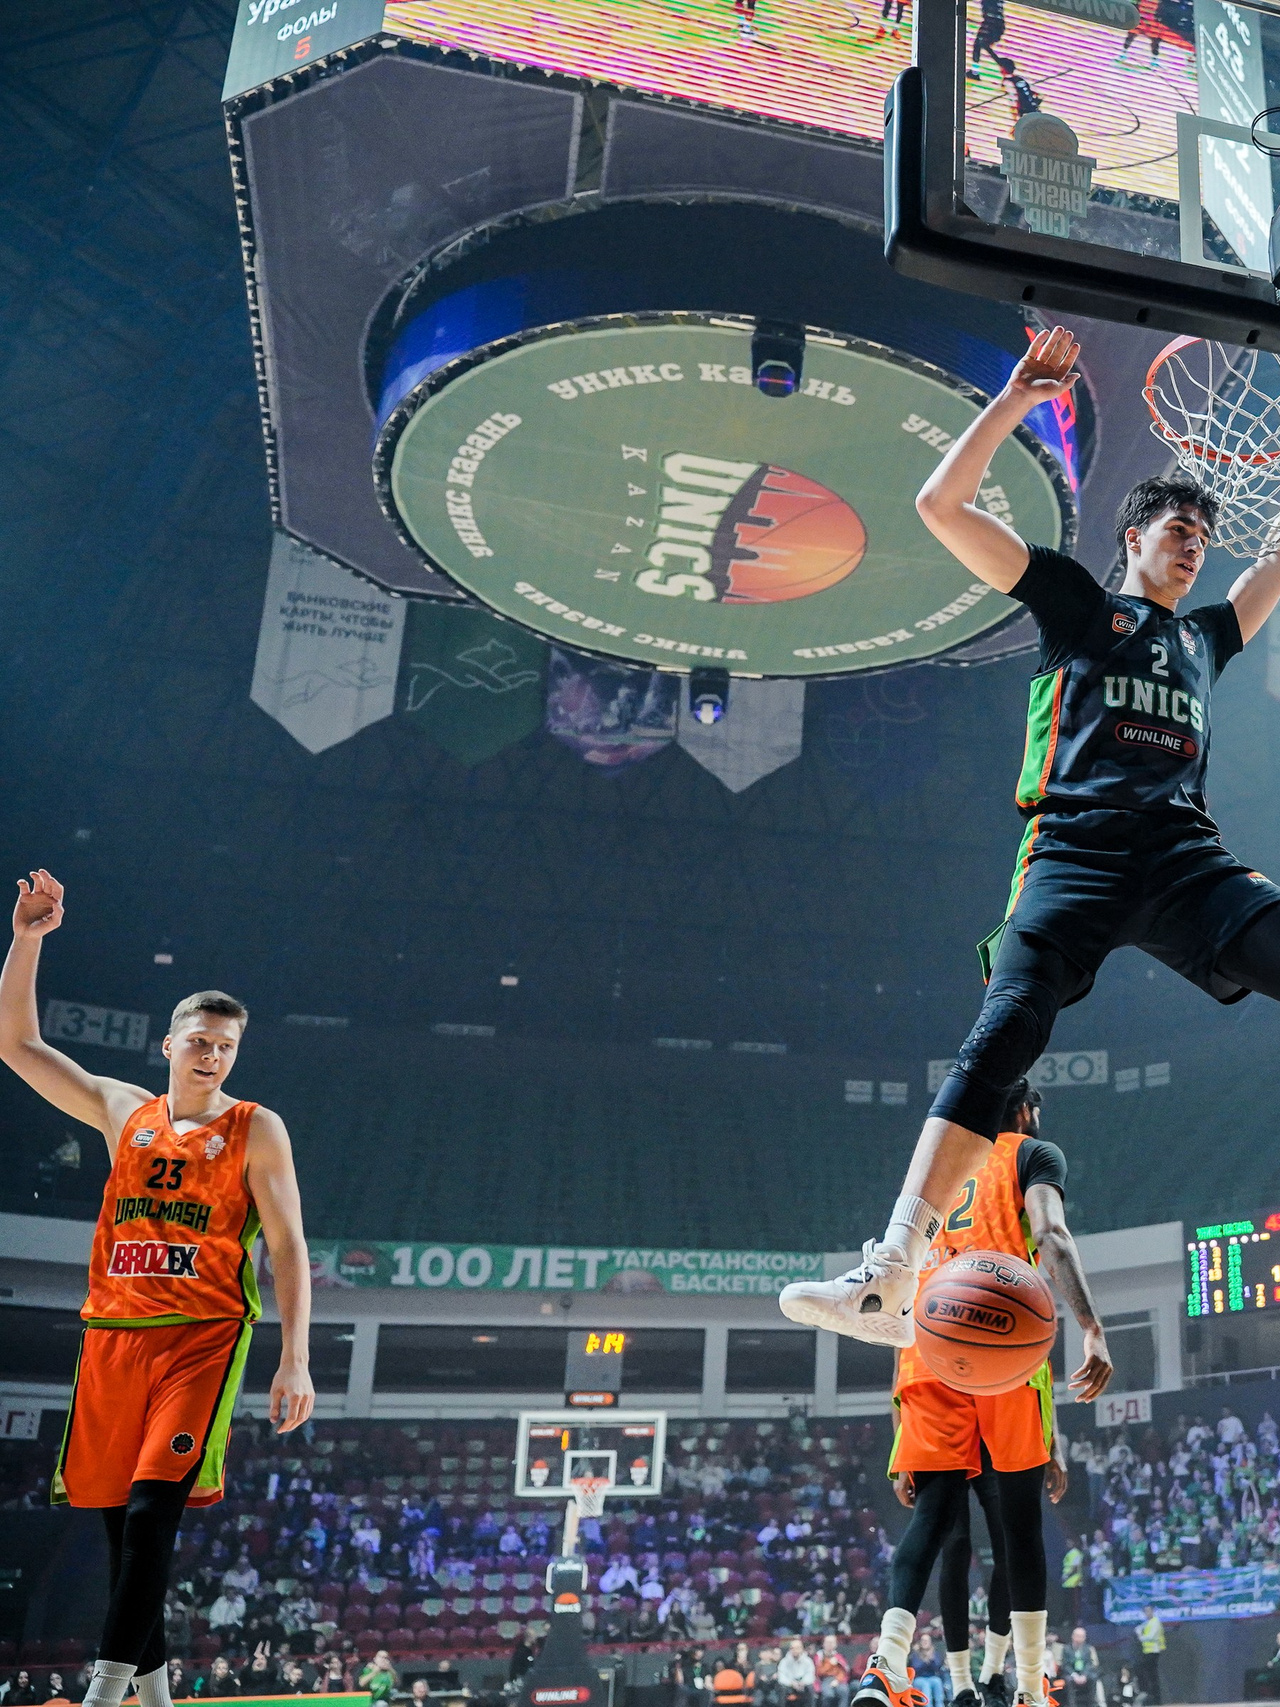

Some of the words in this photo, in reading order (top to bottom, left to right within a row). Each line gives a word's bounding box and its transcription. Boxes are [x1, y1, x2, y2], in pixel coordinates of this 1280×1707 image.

[294, 35, 312, 60] 5
[635, 450, 763, 602] UNICS
[1151, 643, 1170, 678] 2
[1103, 675, 1204, 734] UNICS
[1122, 726, 1183, 751] WINLINE
[147, 1157, 187, 1191] 23
[114, 1197, 213, 1234] URALMASH
[109, 1241, 199, 1277] BROZEX
[391, 1246, 494, 1288] 100
[502, 1248, 608, 1289] ЛЕТ
[611, 1249, 823, 1273] ТАТАРСТАНСКОМУ
[671, 1272, 821, 1293] БАСКЕТБО
[939, 1302, 1009, 1330] WINLINE
[535, 1689, 579, 1702] WINLINE
